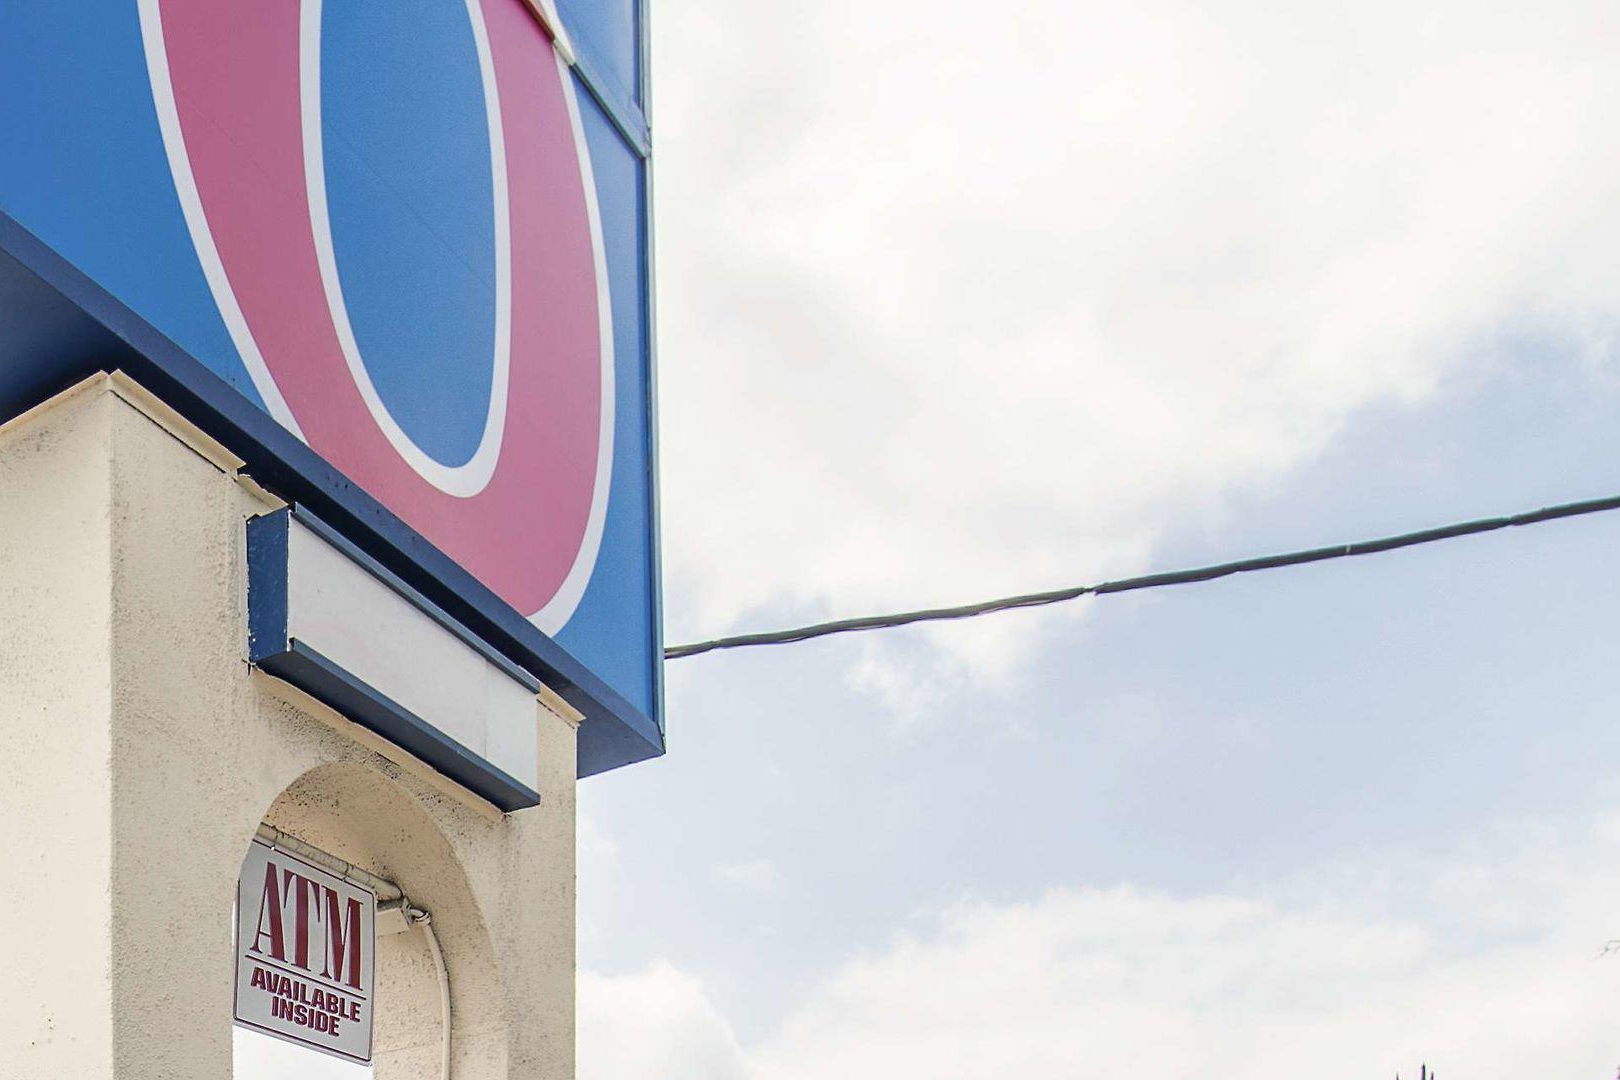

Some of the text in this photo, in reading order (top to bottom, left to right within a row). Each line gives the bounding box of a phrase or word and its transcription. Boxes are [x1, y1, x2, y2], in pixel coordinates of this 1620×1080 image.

[249, 861, 364, 991] ATM
[251, 967, 362, 1022] AVAILABLE
[271, 996, 340, 1037] INSIDE
